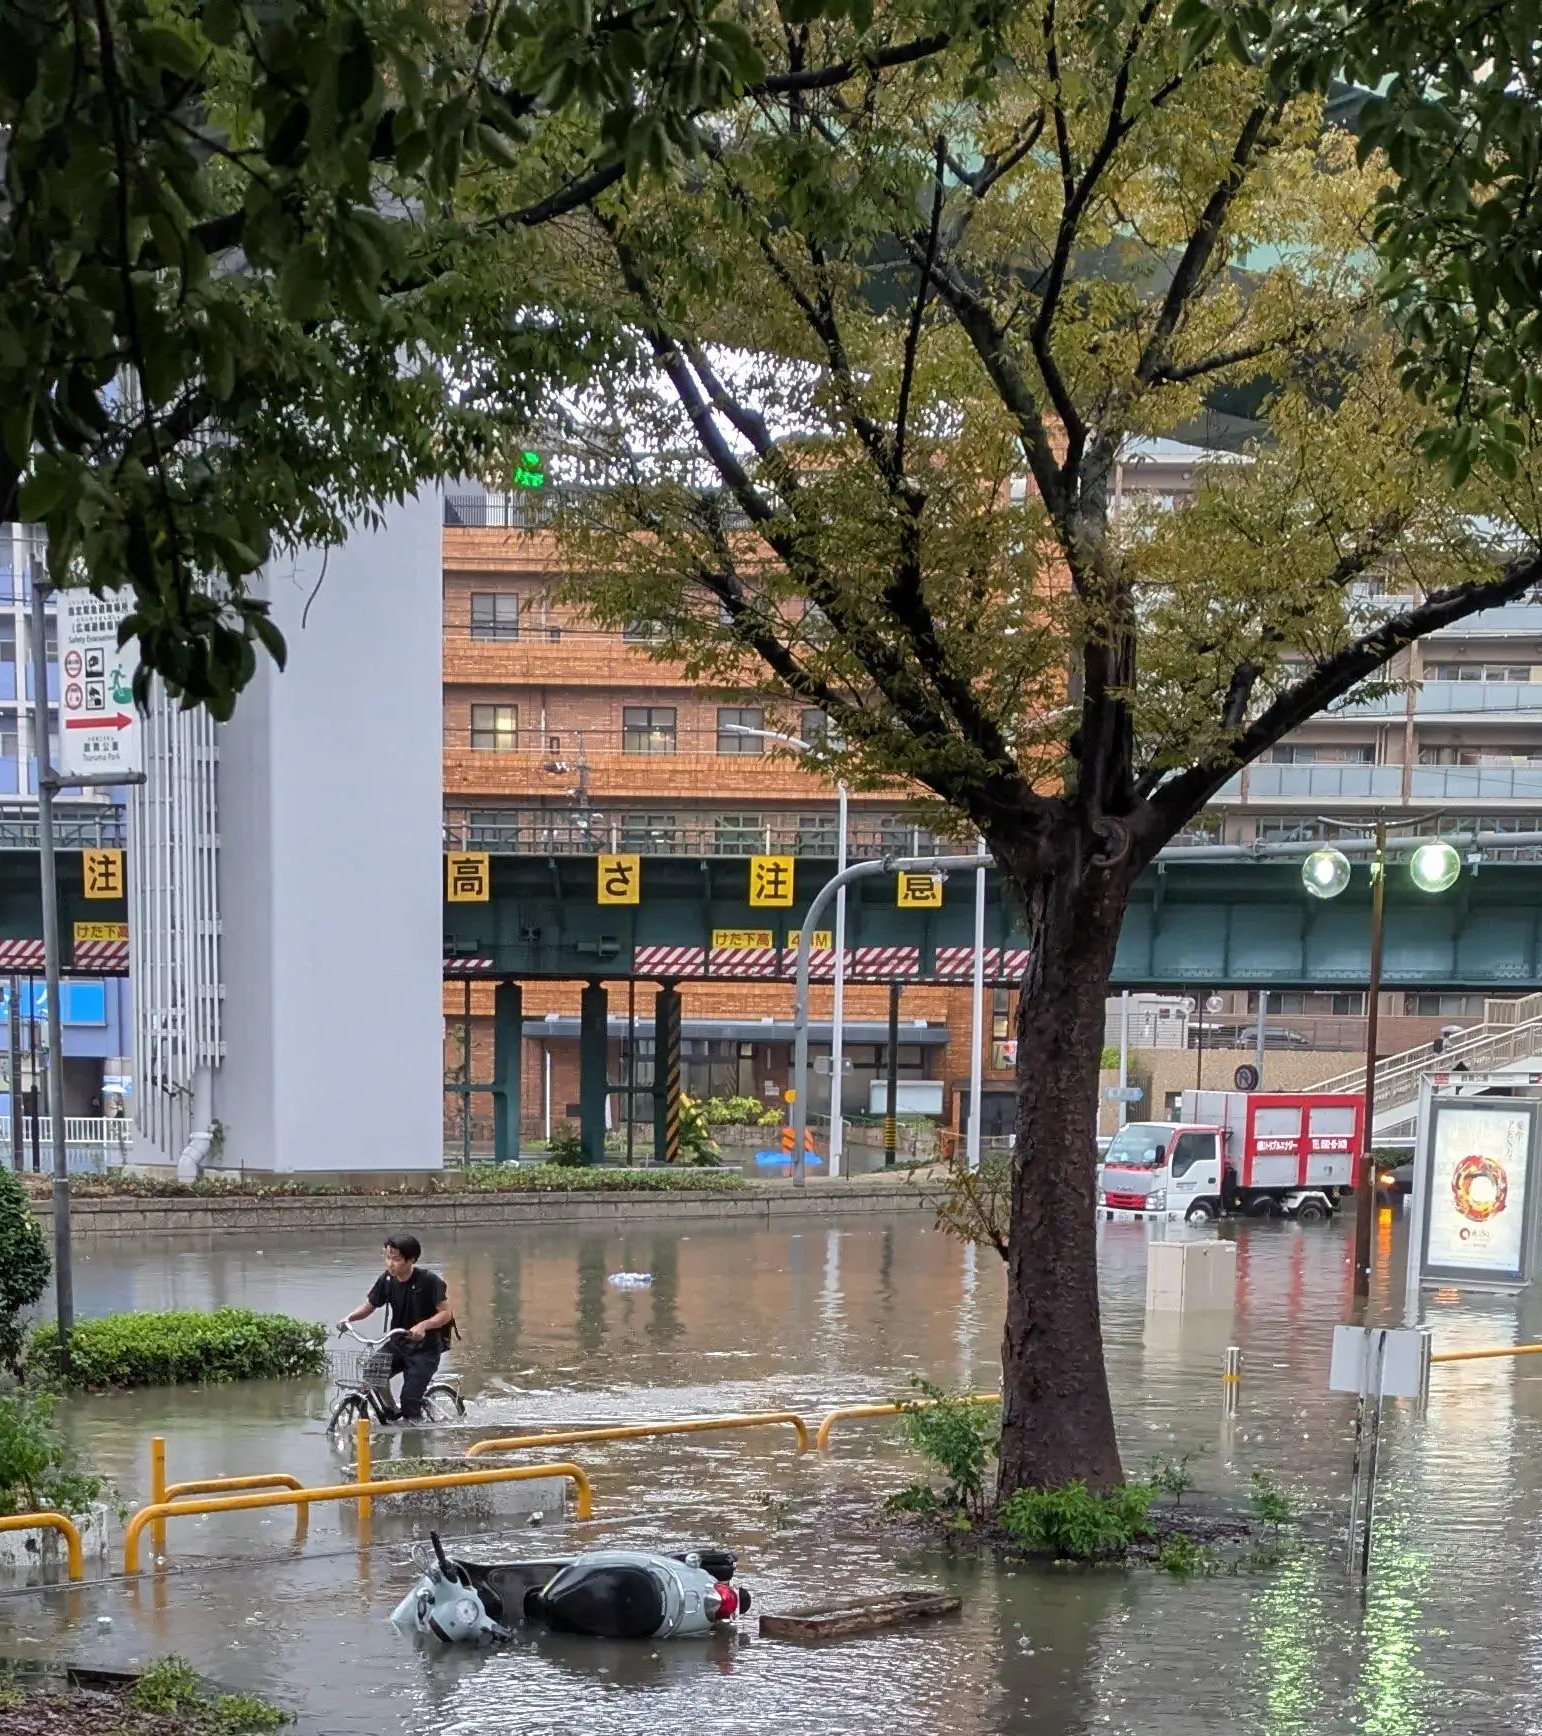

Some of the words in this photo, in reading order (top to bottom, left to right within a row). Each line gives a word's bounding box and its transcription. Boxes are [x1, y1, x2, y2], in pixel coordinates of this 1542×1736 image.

[88, 854, 118, 891] 注
[452, 858, 484, 896] 高
[605, 861, 633, 896] さ
[756, 861, 789, 900] 注
[715, 932, 770, 946] けた下高
